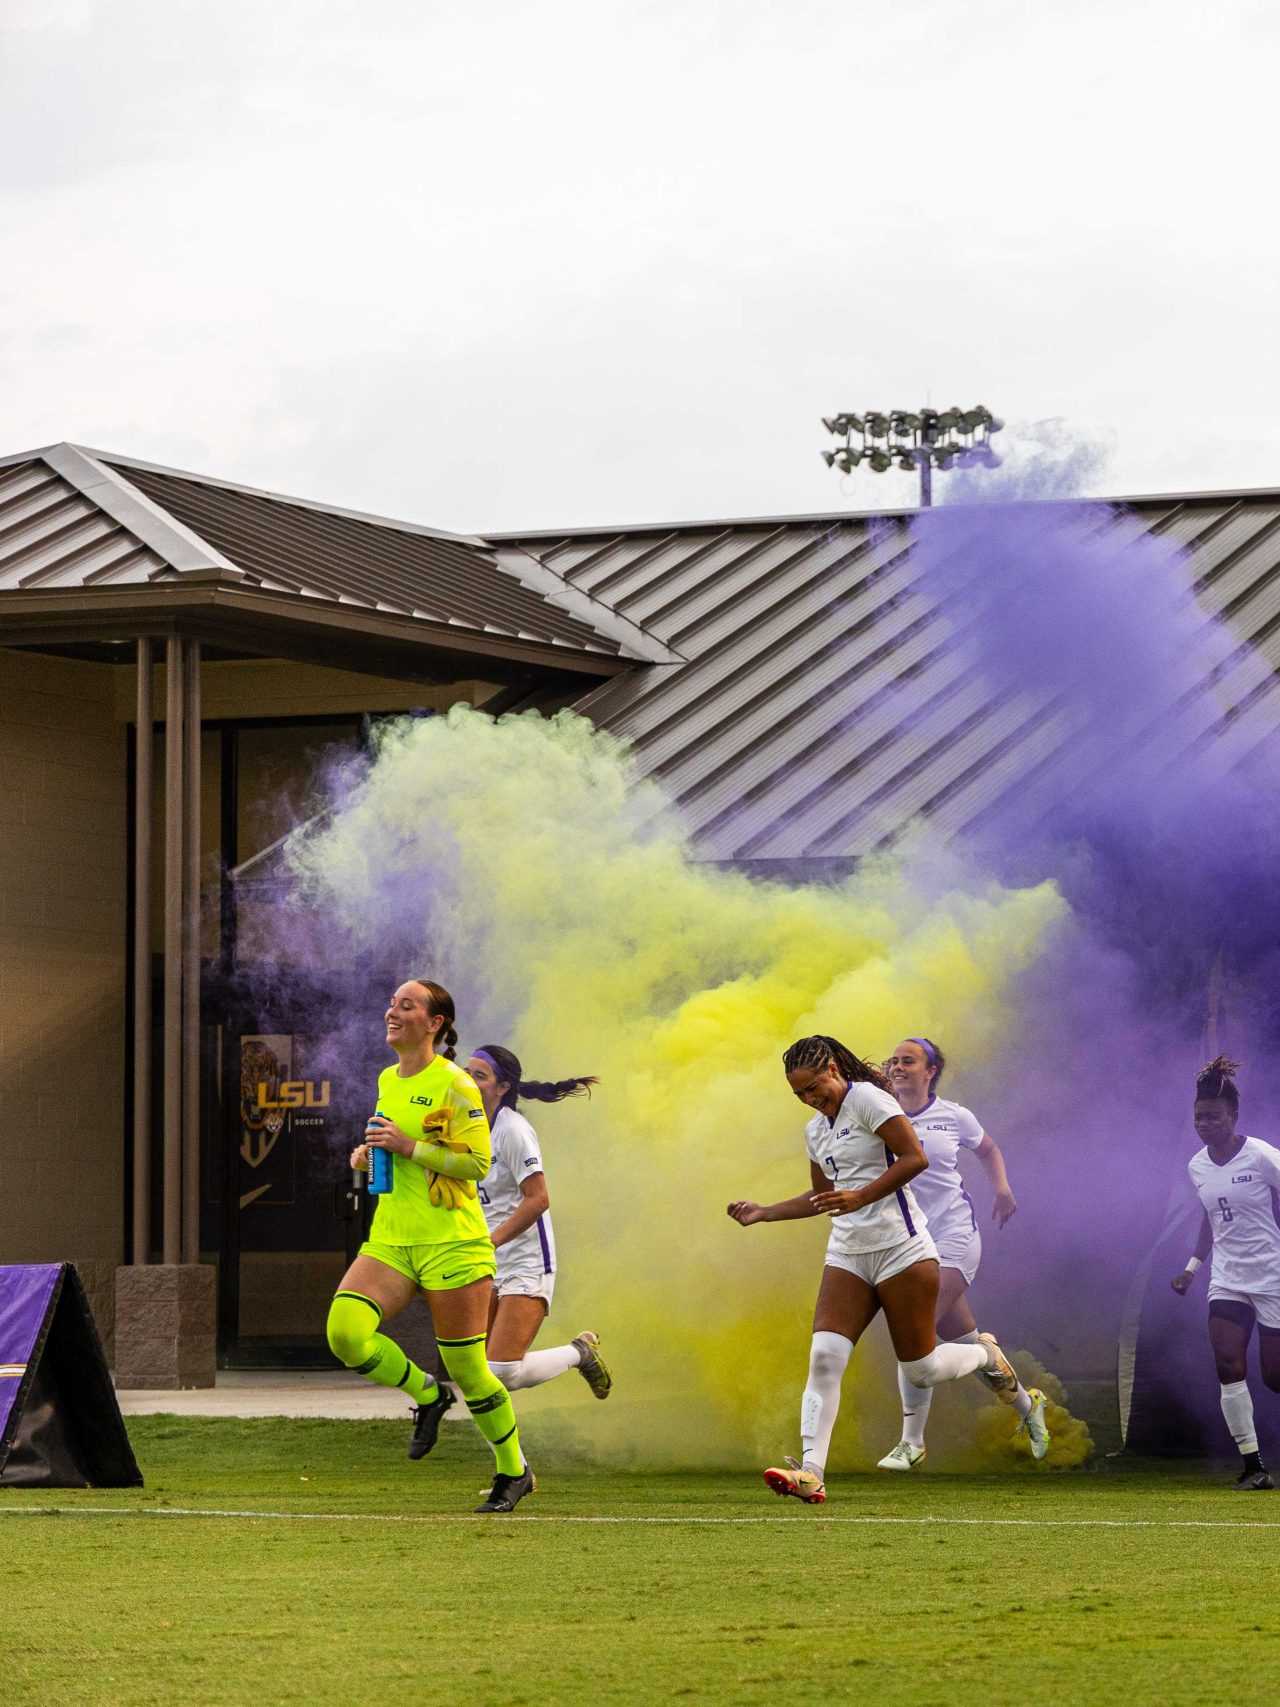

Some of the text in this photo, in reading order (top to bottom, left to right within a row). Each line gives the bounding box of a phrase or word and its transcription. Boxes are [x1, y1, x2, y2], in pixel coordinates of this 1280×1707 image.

[257, 1081, 330, 1108] LSU
[410, 1096, 433, 1107] LSU
[295, 1118, 324, 1126] SOCCER
[837, 1128, 850, 1140] LSU
[826, 1156, 839, 1181] 7
[1232, 1174, 1252, 1184] LSU
[1218, 1197, 1233, 1222] 6
